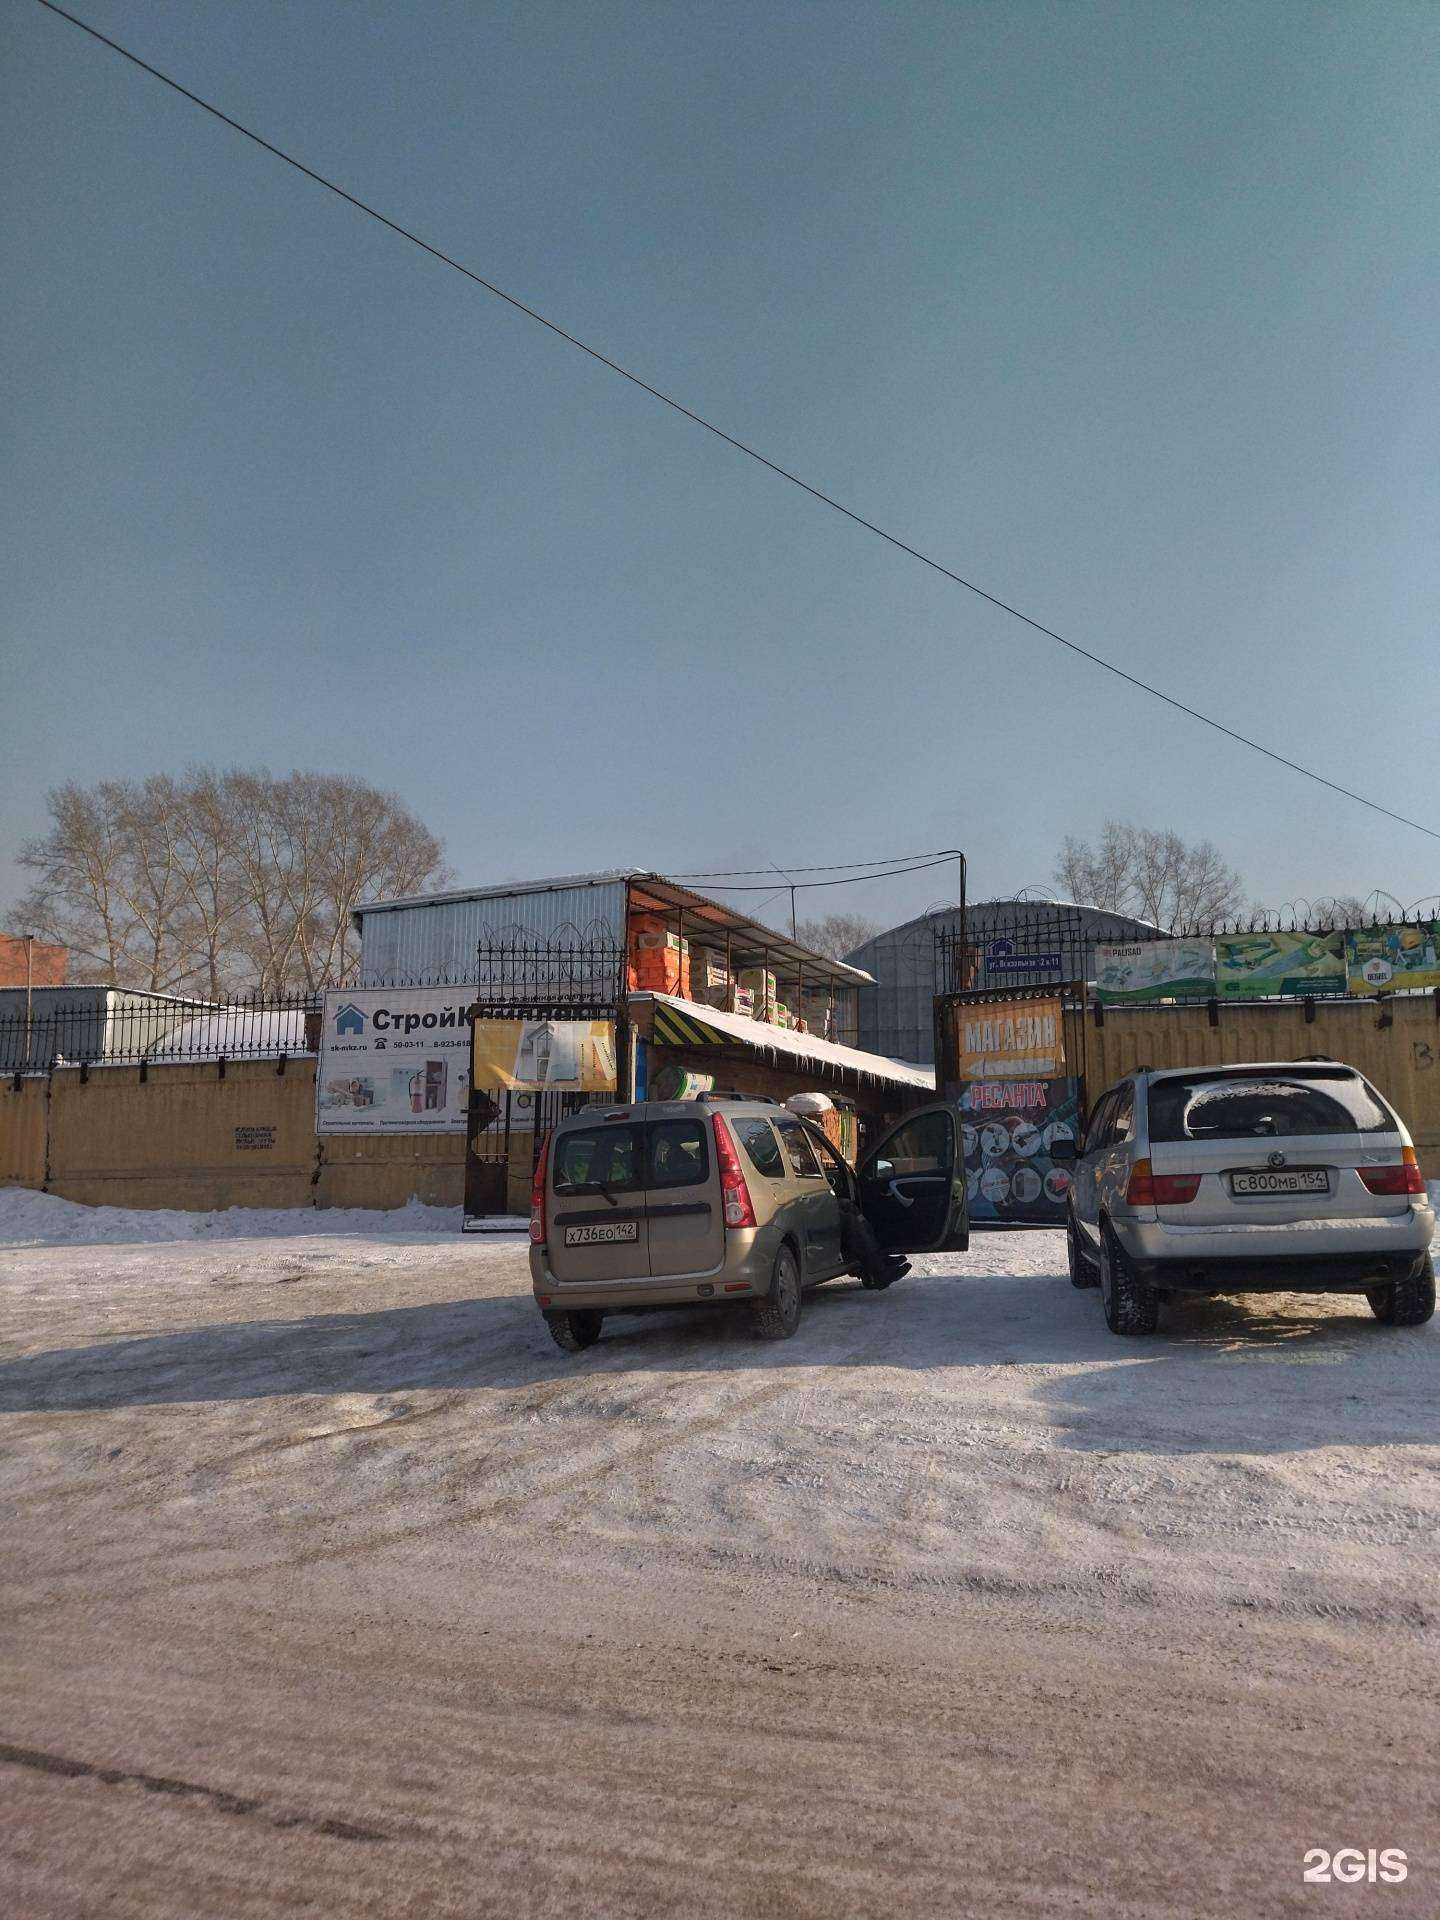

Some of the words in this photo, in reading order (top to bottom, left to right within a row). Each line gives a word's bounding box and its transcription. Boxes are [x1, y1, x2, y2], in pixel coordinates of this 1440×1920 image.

[1112, 948, 1142, 957] PALISAD
[965, 1015, 1056, 1053] МАГАЗИН
[970, 1084, 1047, 1109] РЕСАНТА
[1237, 1174, 1298, 1192] С800МВ
[1301, 1171, 1324, 1185] 154
[569, 1226, 614, 1243] Х736ЕО
[616, 1224, 634, 1235] 142
